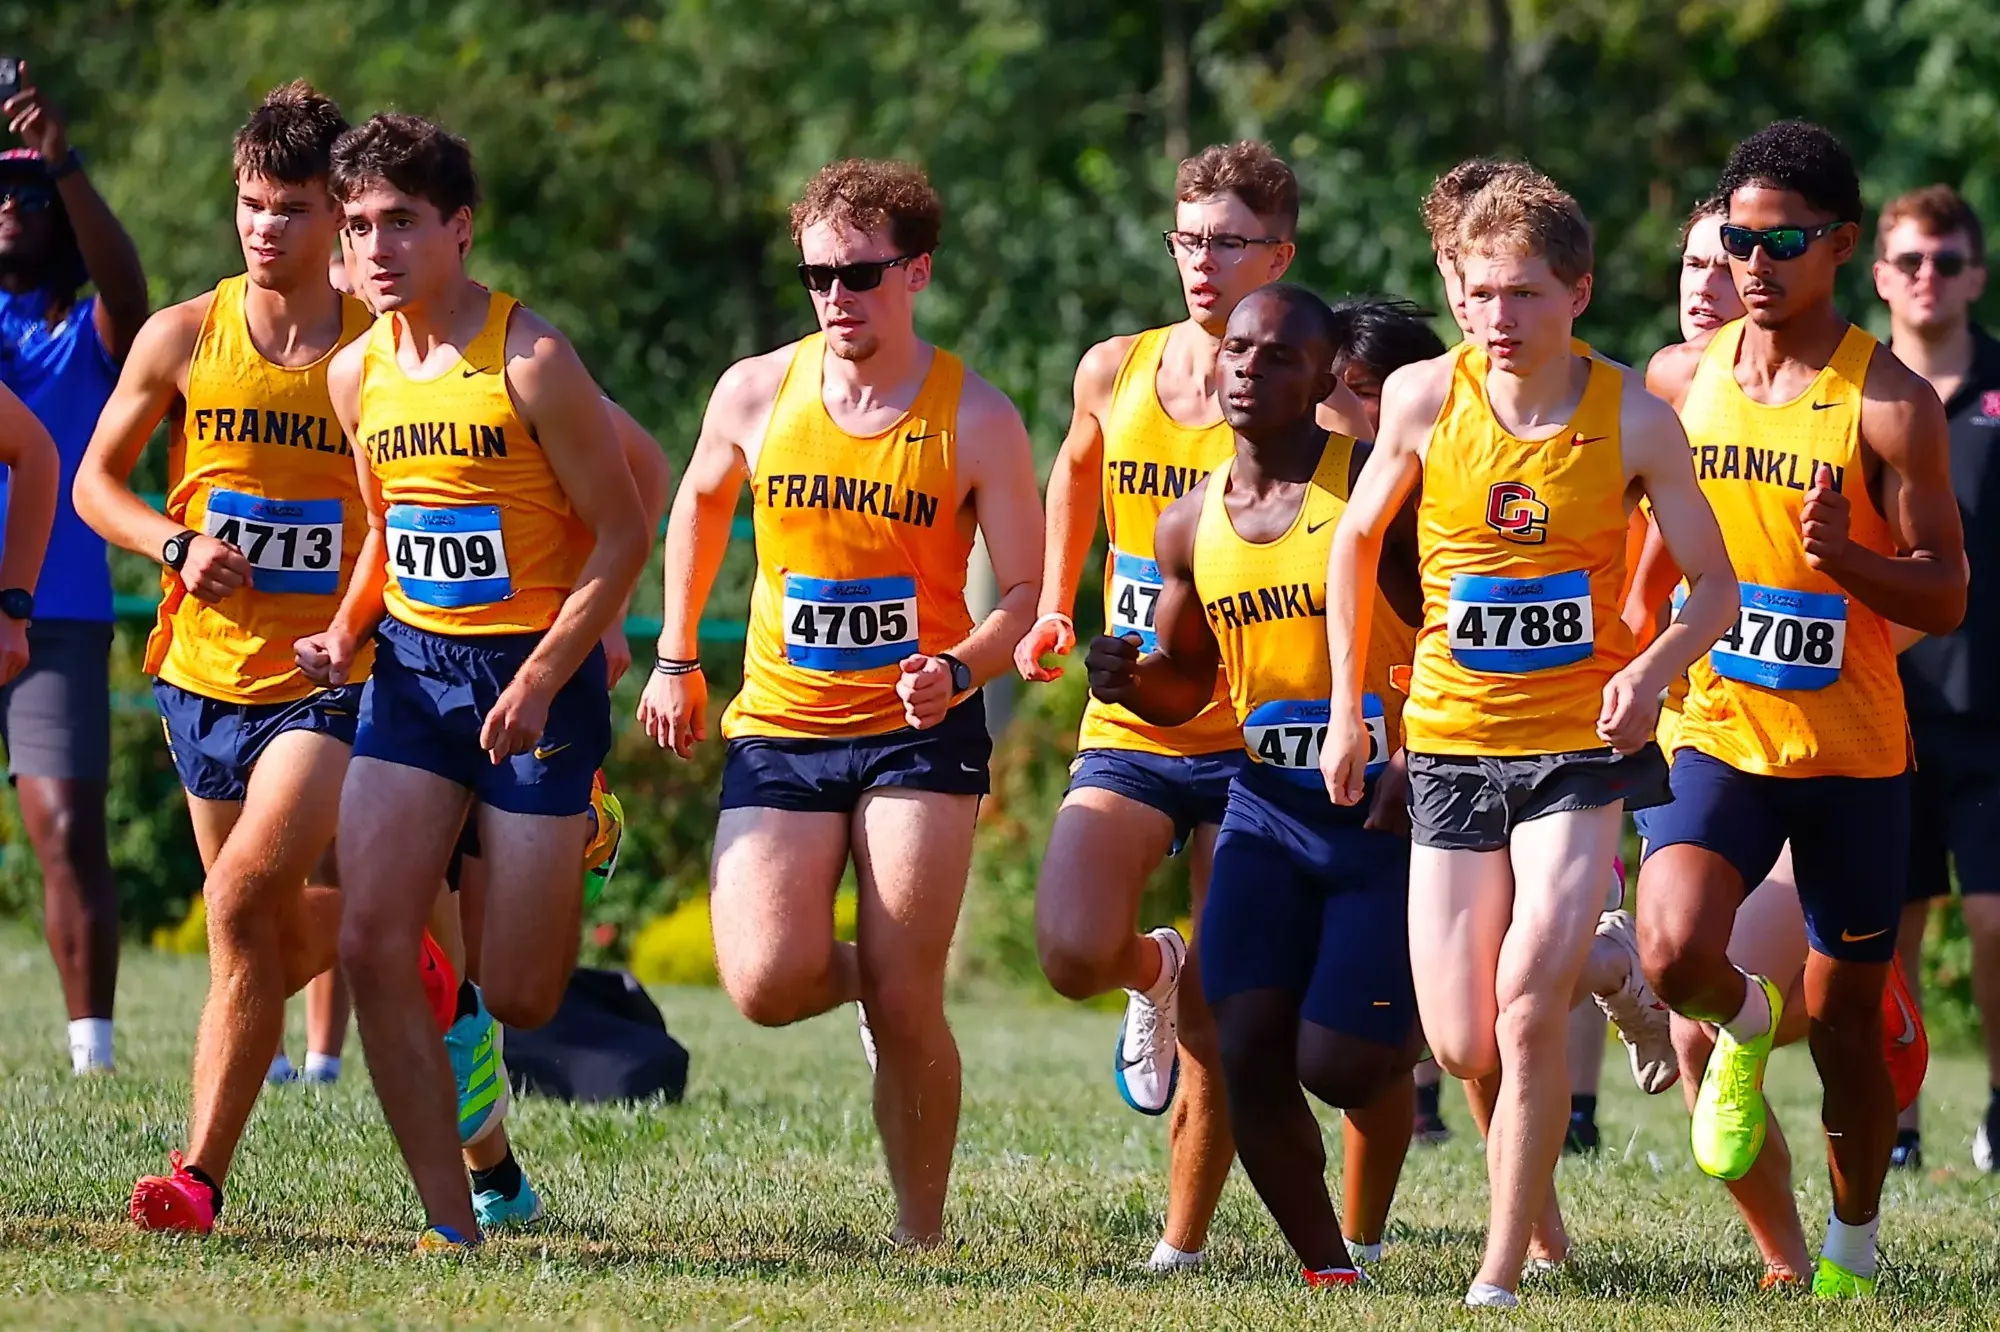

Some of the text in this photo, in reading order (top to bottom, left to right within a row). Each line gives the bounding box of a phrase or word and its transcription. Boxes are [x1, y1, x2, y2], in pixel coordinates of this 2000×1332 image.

[195, 408, 353, 458] FRANKLI
[367, 422, 508, 464] FRANKLIN
[768, 474, 939, 528] FRANKLIN
[214, 518, 333, 569] 4713
[396, 534, 497, 579] 4709
[791, 602, 908, 646] 4705
[1206, 582, 1327, 634] FRANKL
[1456, 601, 1583, 647] 4788
[1720, 610, 1835, 665] 4708
